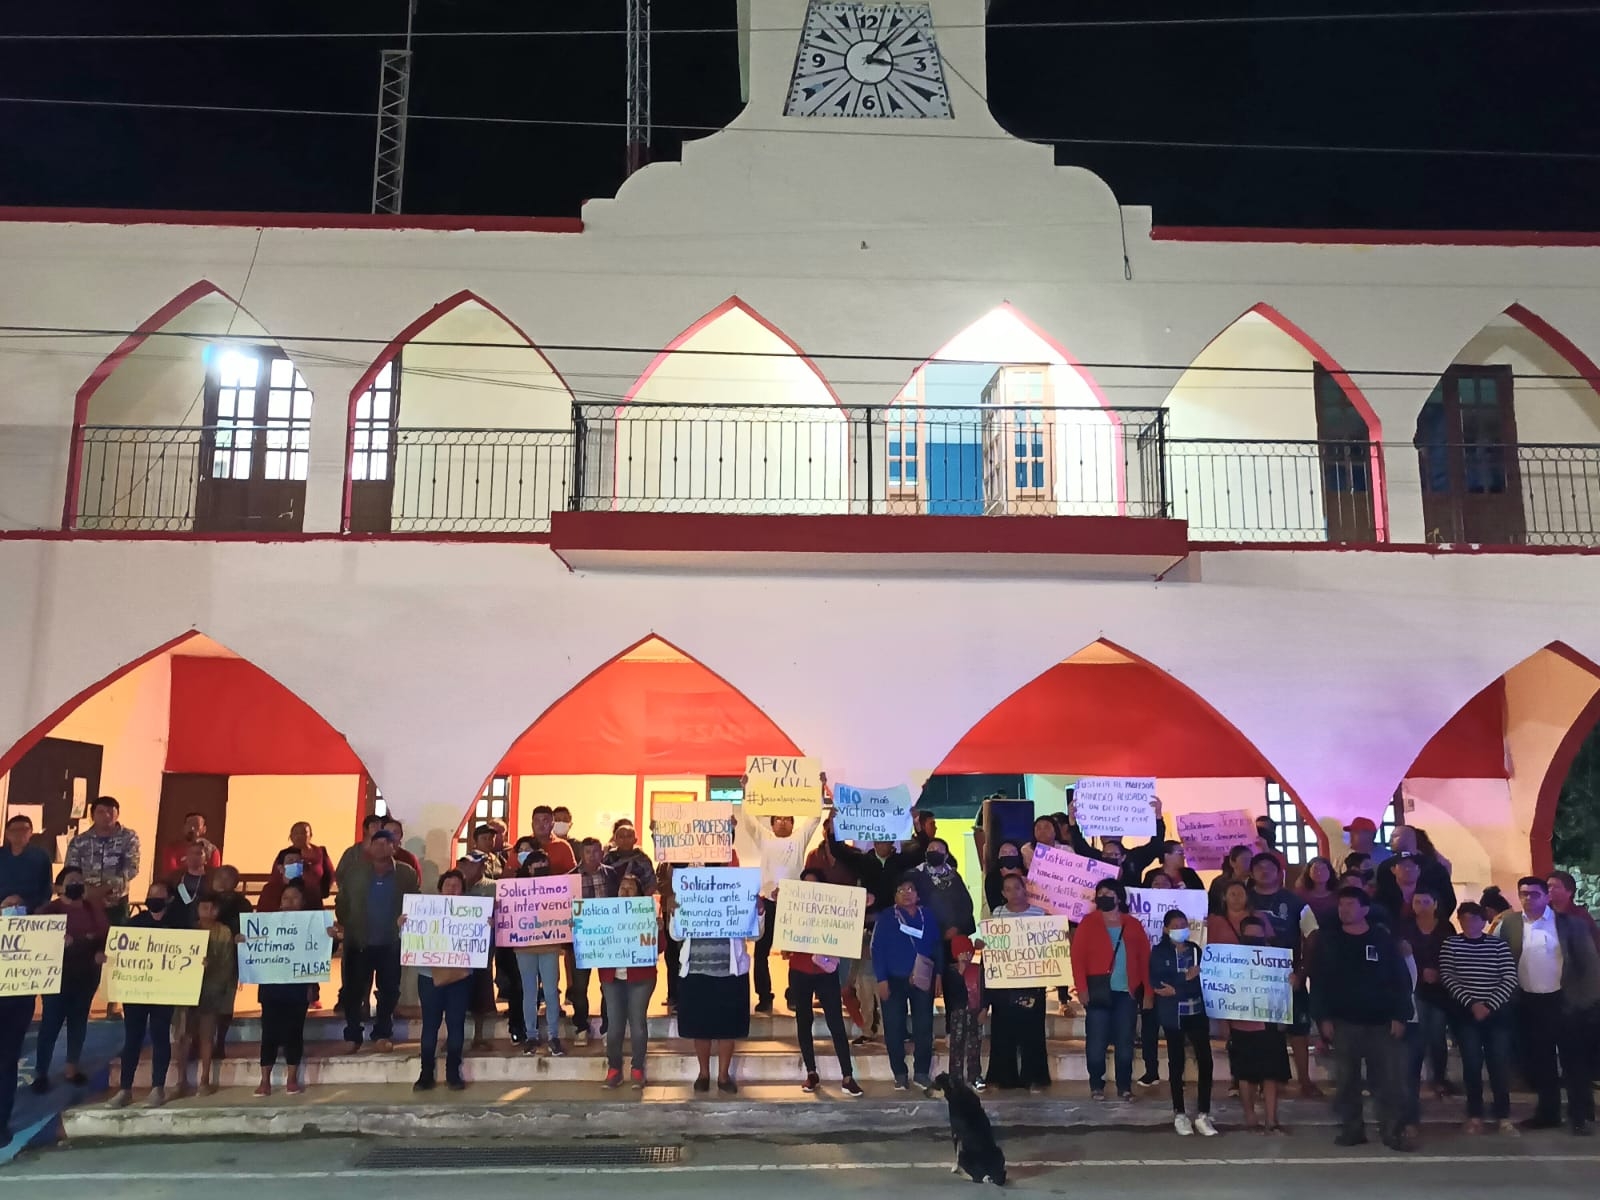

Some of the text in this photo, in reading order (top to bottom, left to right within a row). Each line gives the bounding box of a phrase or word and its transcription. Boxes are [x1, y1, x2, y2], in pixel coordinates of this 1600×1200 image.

[857, 14, 879, 30] 12
[812, 53, 826, 68] 9
[913, 56, 927, 72] 3
[861, 94, 876, 110] 6
[840, 786, 862, 805] NO
[892, 805, 905, 817] de
[838, 819, 886, 833] denuncias
[1035, 844, 1073, 868] Justicia
[499, 879, 568, 897] Solicitamos
[680, 874, 742, 891] Solicitamos
[719, 890, 741, 902] ante
[848, 890, 858, 909] la
[1128, 892, 1151, 913] No
[498, 898, 509, 914] la
[573, 900, 610, 917] Justicia
[611, 903, 620, 915] al
[679, 907, 722, 918] denuncias
[247, 917, 298, 938] No más
[497, 914, 514, 930] del
[573, 918, 614, 935] Francisco
[691, 917, 720, 928] contra
[726, 915, 739, 927] del
[981, 919, 1011, 935] Todo
[542, 928, 567, 941] Vila
[304, 934, 319, 952] de
[245, 954, 291, 965] denuncias
[983, 948, 1036, 963] FRANCISCO
[292, 959, 331, 977] FALSAS
[986, 958, 1061, 980] del SISTEMA
[1202, 978, 1237, 995] FALSAS
